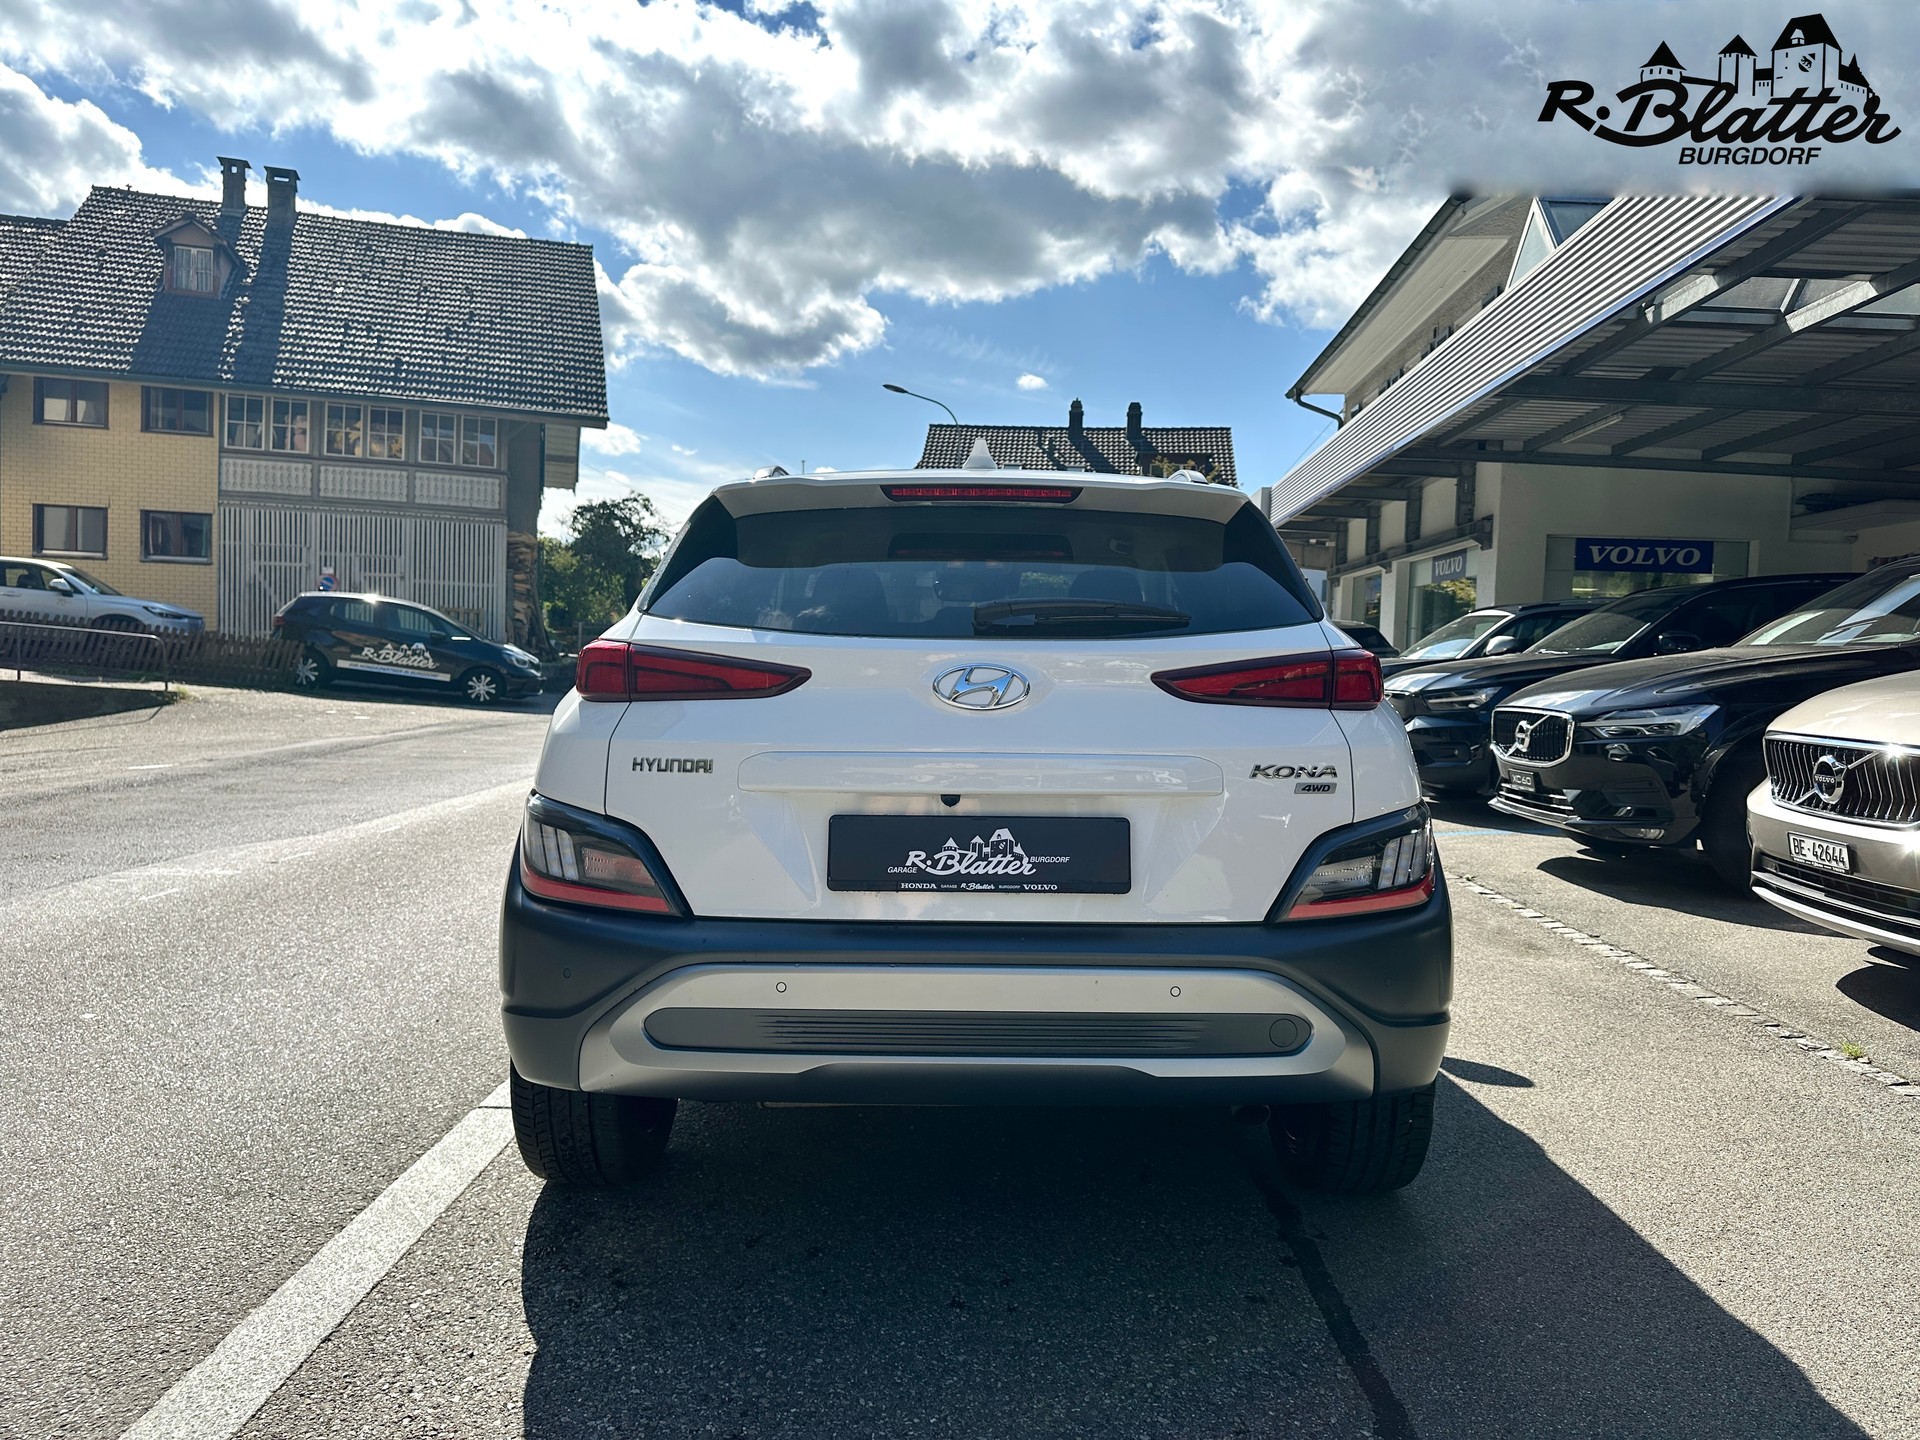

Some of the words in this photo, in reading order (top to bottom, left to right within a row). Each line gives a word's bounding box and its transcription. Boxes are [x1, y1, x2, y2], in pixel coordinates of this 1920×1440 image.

[1589, 545, 1701, 566] VOLVO
[1434, 556, 1463, 576] VOLVO
[632, 757, 714, 774] HYUNDAI
[1249, 764, 1338, 779] KONA
[1511, 774, 1532, 785] XC60
[1814, 775, 1835, 783] VOLVO
[1301, 784, 1331, 792] 4WD
[887, 866, 918, 874] GARAGE
[1029, 856, 1071, 864] BURGDORF
